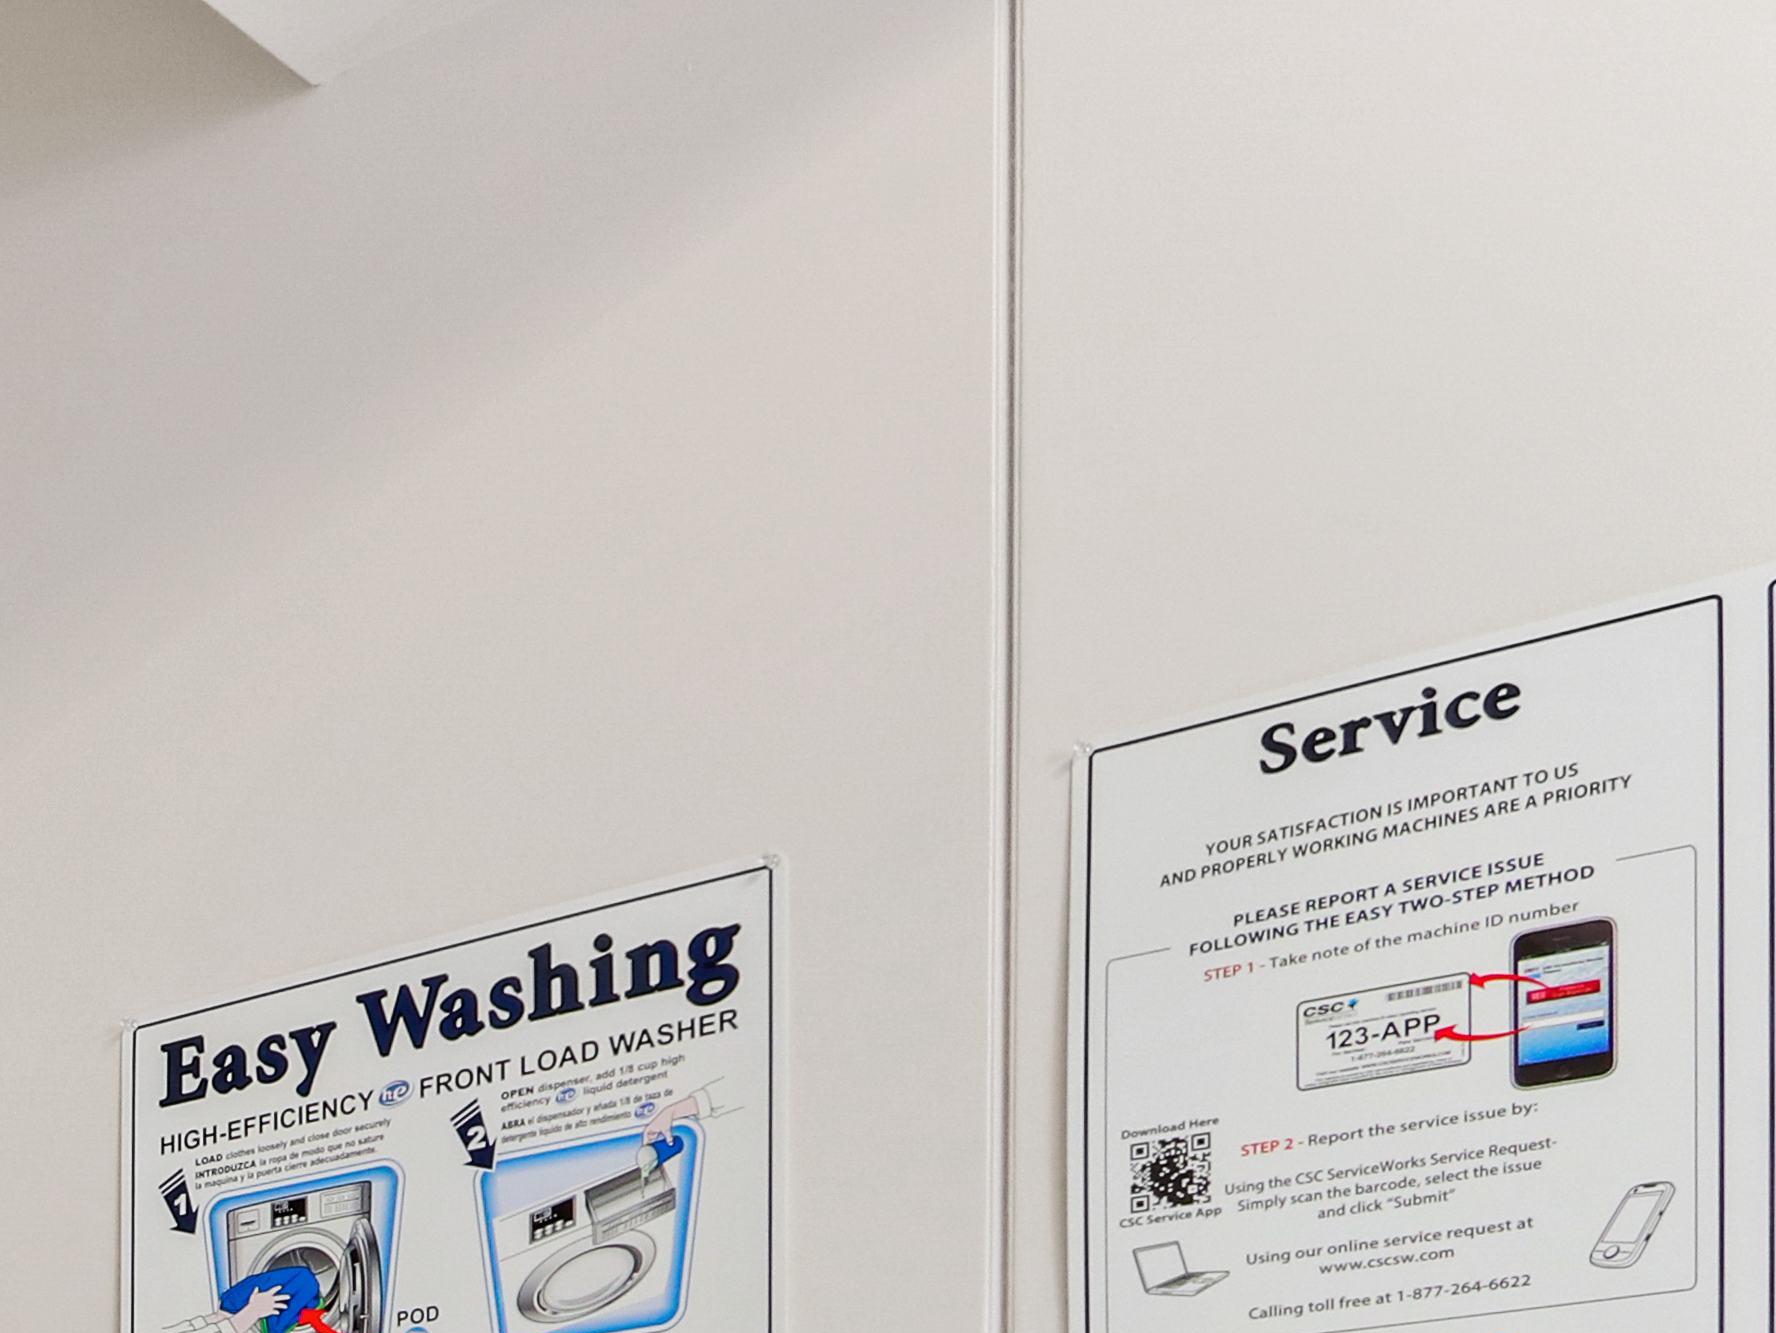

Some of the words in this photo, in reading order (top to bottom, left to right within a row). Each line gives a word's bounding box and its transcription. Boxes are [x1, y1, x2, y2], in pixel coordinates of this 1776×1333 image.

[1260, 682, 1521, 774] Service
[1160, 869, 1196, 887] AND
[1201, 849, 1287, 878] PROPERLY
[1293, 829, 1377, 857] WORKING
[1383, 807, 1478, 839] MACHINES
[1484, 798, 1519, 817] ARE
[1525, 796, 1537, 809] A
[1543, 774, 1632, 805] PRIORITY
[1206, 835, 1252, 855] YOUR
[1258, 806, 1382, 846] SATISFACTION
[1388, 801, 1402, 815] IS
[1408, 776, 1518, 811] IMPORTANT
[1524, 770, 1548, 786] TO
[1555, 763, 1578, 779] US
[1190, 923, 1298, 956] FOLLOWING
[1305, 915, 1339, 932] THE
[1345, 905, 1393, 924] EASY
[1400, 884, 1498, 913] TWO-STEP
[1505, 866, 1595, 893] METHOD
[1234, 902, 1300, 926] PLEASE
[1306, 886, 1379, 912] REPORT
[1384, 883, 1396, 896] A
[1403, 865, 1482, 892] SERVICE
[1488, 853, 1544, 875] ISSUE
[1204, 964, 1242, 981] STEP
[1248, 962, 1253, 972] 1
[1269, 955, 1307, 968] Take
[1312, 946, 1348, 961] note
[1354, 938, 1371, 952] of
[1376, 935, 1401, 948] the
[1408, 921, 1480, 942] machine
[1486, 914, 1503, 927] ID
[1509, 902, 1579, 923] number
[159, 1021, 337, 1107] Easy
[356, 923, 742, 1058] Washing
[1326, 1014, 1440, 1049] 123-APP
[161, 1090, 374, 1155] HIGH-EFFICIENCY
[419, 1059, 511, 1099] FRONT
[521, 1039, 599, 1075] LOAD
[609, 1009, 739, 1054] WASHER
[467, 1125, 486, 1151] 2
[1241, 1140, 1279, 1156] STEP
[1286, 1139, 1294, 1149] 2
[1308, 1129, 1363, 1146] Report
[1369, 1125, 1395, 1137] the
[1400, 1114, 1459, 1132] service
[1464, 1106, 1507, 1123] issue
[1512, 1102, 1538, 1116] by:
[1225, 1182, 1264, 1196] Using
[1269, 1178, 1292, 1189] the
[1295, 1172, 1323, 1185] CSC
[1327, 1155, 1426, 1181] ServiceWorks
[1431, 1150, 1484, 1166] Service
[1238, 1196, 1285, 1214] Simply
[1291, 1191, 1322, 1204] scan
[1327, 1187, 1351, 1198] the
[1355, 1177, 1421, 1196] barcode,
[1425, 1171, 1469, 1185] select
[1474, 1164, 1498, 1177] the
[1503, 1160, 1542, 1174] issue
[174, 1193, 187, 1215] 1
[1318, 1205, 1345, 1219] and
[1350, 1200, 1382, 1214] click
[1246, 1251, 1291, 1266] Using
[1295, 1247, 1322, 1259] our
[1327, 1238, 1379, 1255] online
[1384, 1229, 1442, 1247] service
[1447, 1220, 1511, 1240] request
[1517, 1218, 1533, 1229] at
[1319, 1247, 1455, 1275] www.cscsw.com
[397, 1305, 440, 1327] POD
[1249, 1304, 1303, 1320] Calling
[1308, 1299, 1334, 1312] toll
[1339, 1293, 1371, 1308] free
[1375, 1293, 1393, 1304] at
[1398, 1275, 1531, 1302] 1-877-264-6622
